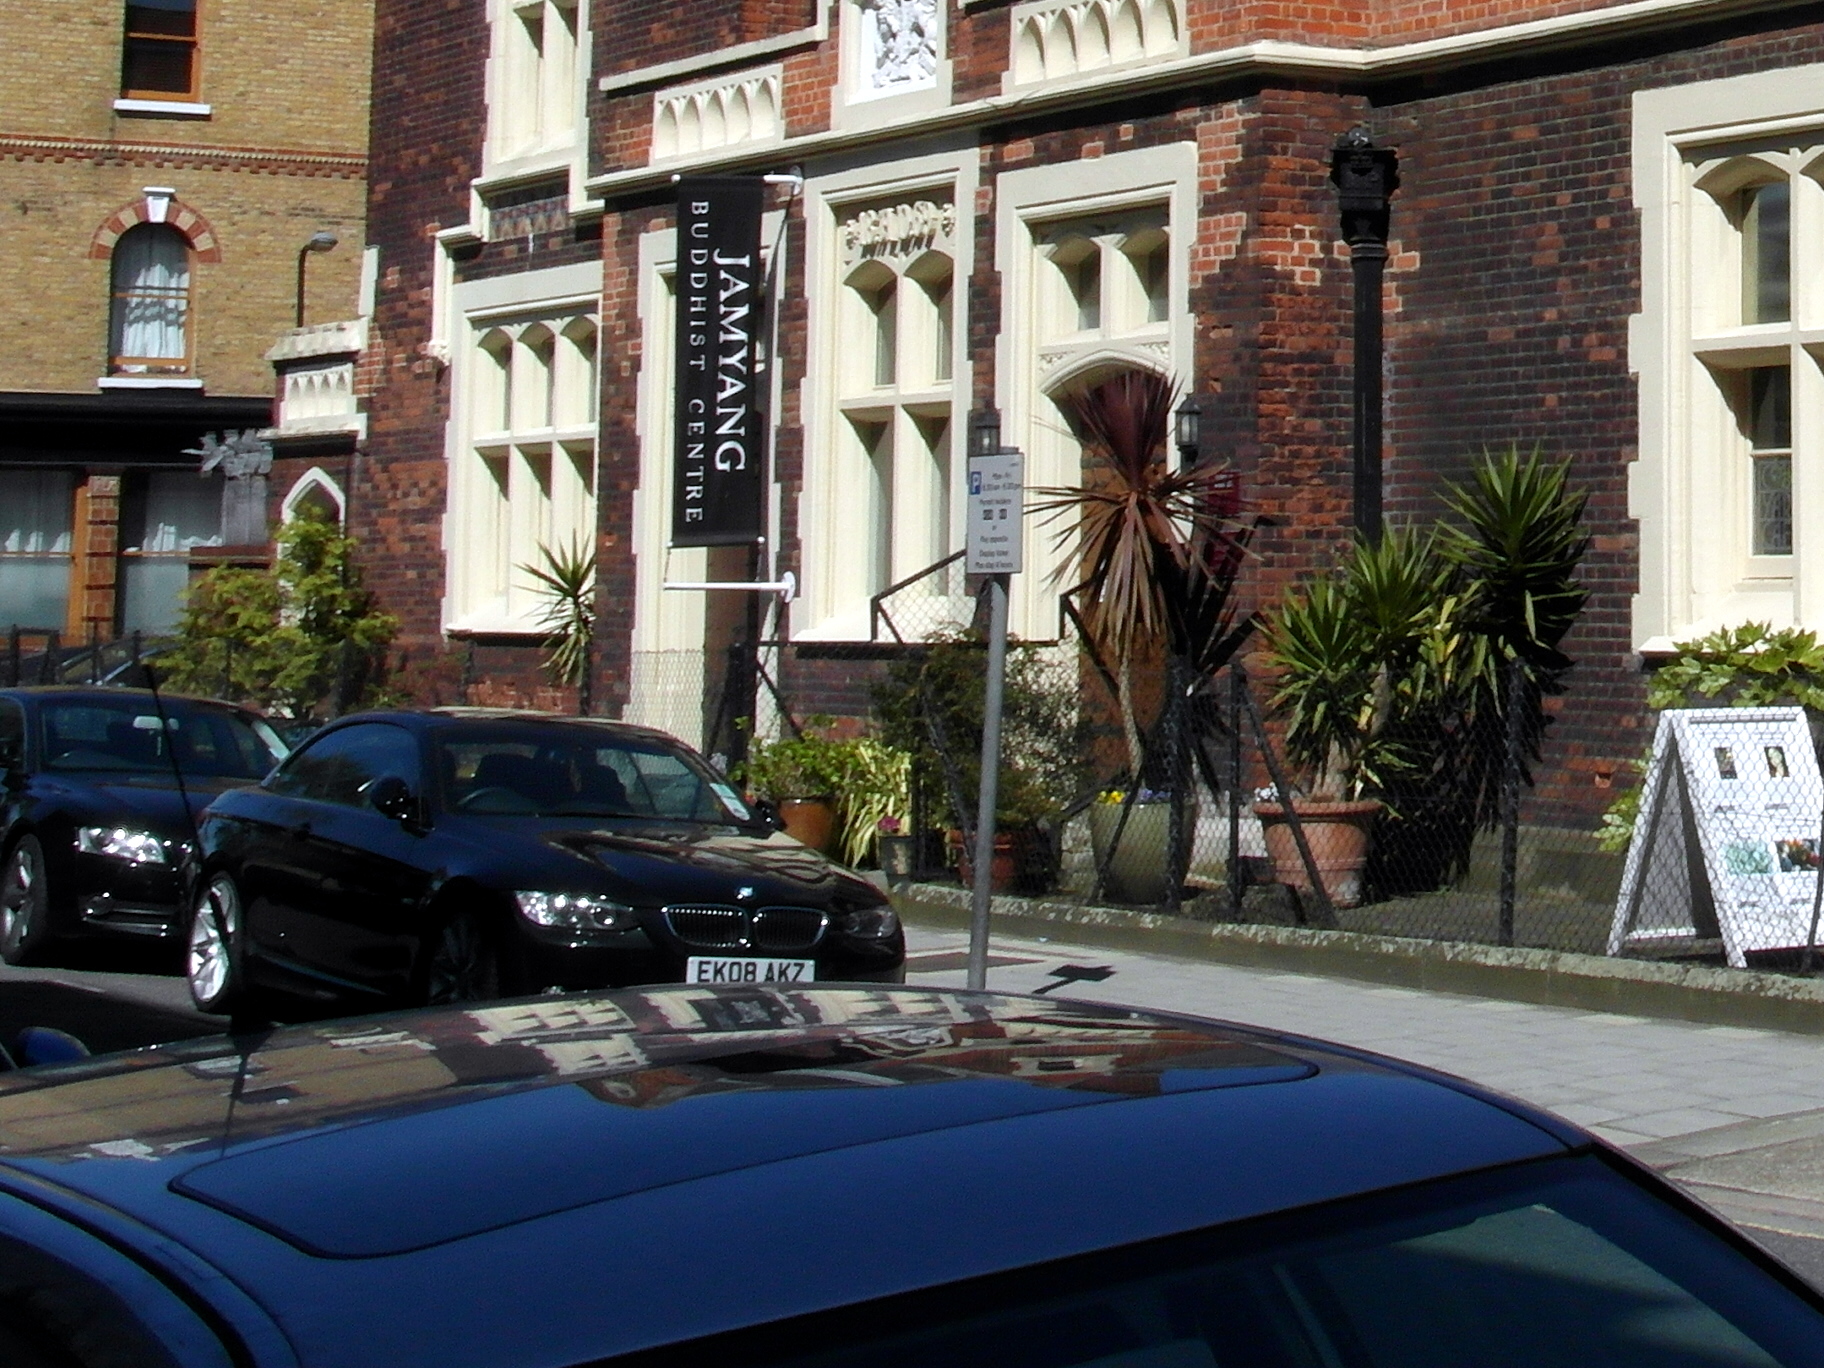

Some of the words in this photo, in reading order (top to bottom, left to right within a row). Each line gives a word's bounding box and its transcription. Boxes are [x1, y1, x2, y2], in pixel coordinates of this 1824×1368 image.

[688, 200, 709, 371] BUDDHIST
[714, 248, 750, 472] JAMYANG
[685, 398, 707, 523] CENTRE
[697, 961, 757, 983] EK08
